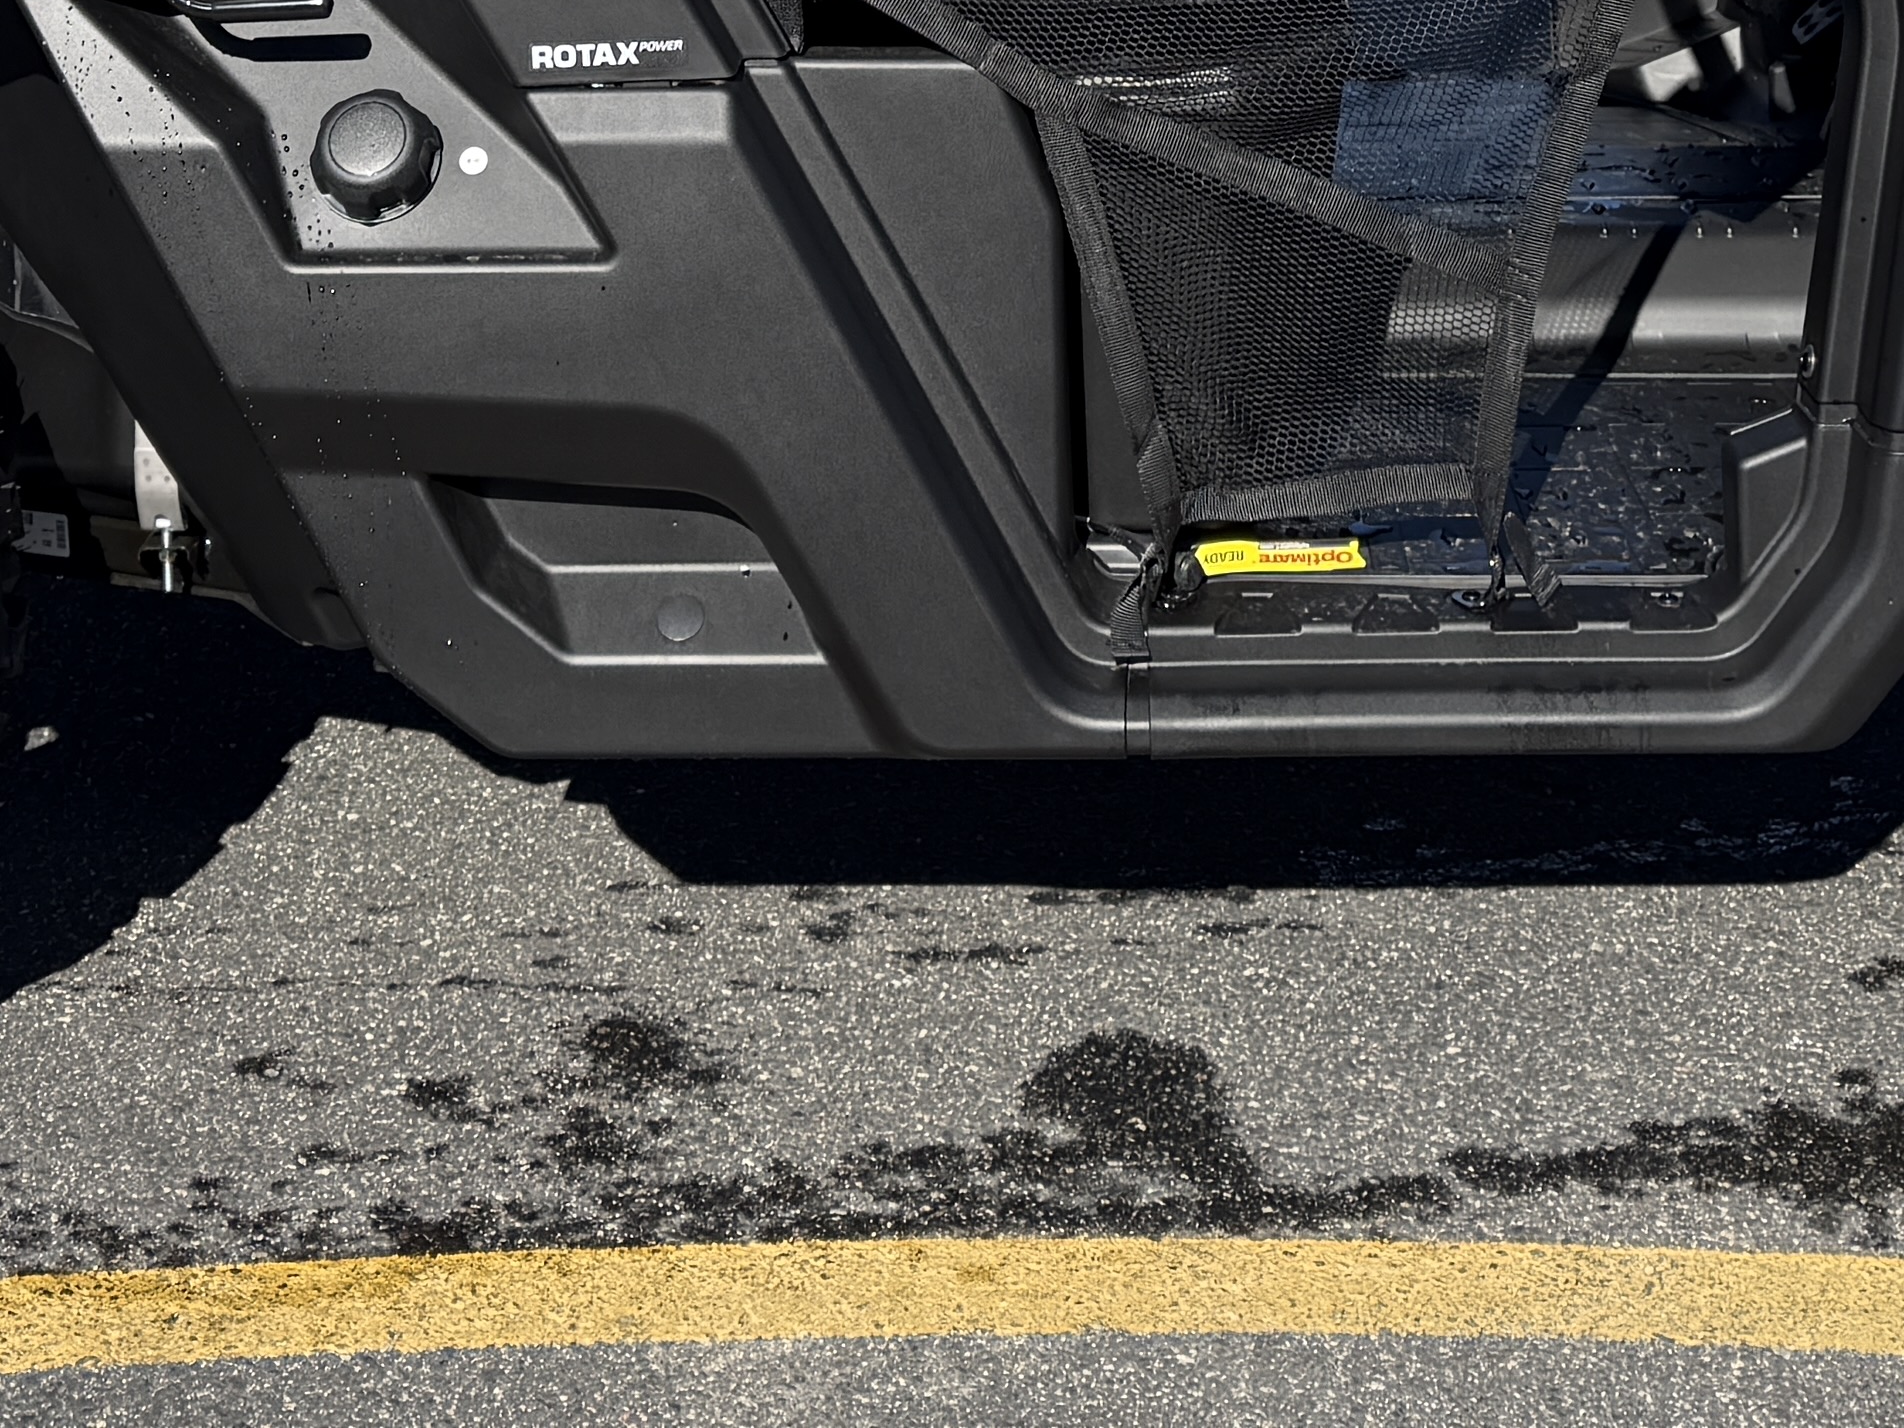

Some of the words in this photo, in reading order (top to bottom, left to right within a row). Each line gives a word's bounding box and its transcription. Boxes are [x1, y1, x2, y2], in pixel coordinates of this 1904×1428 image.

[531, 41, 640, 70] ROTAX
[639, 39, 684, 53] POWER
[1203, 550, 1244, 564] READY
